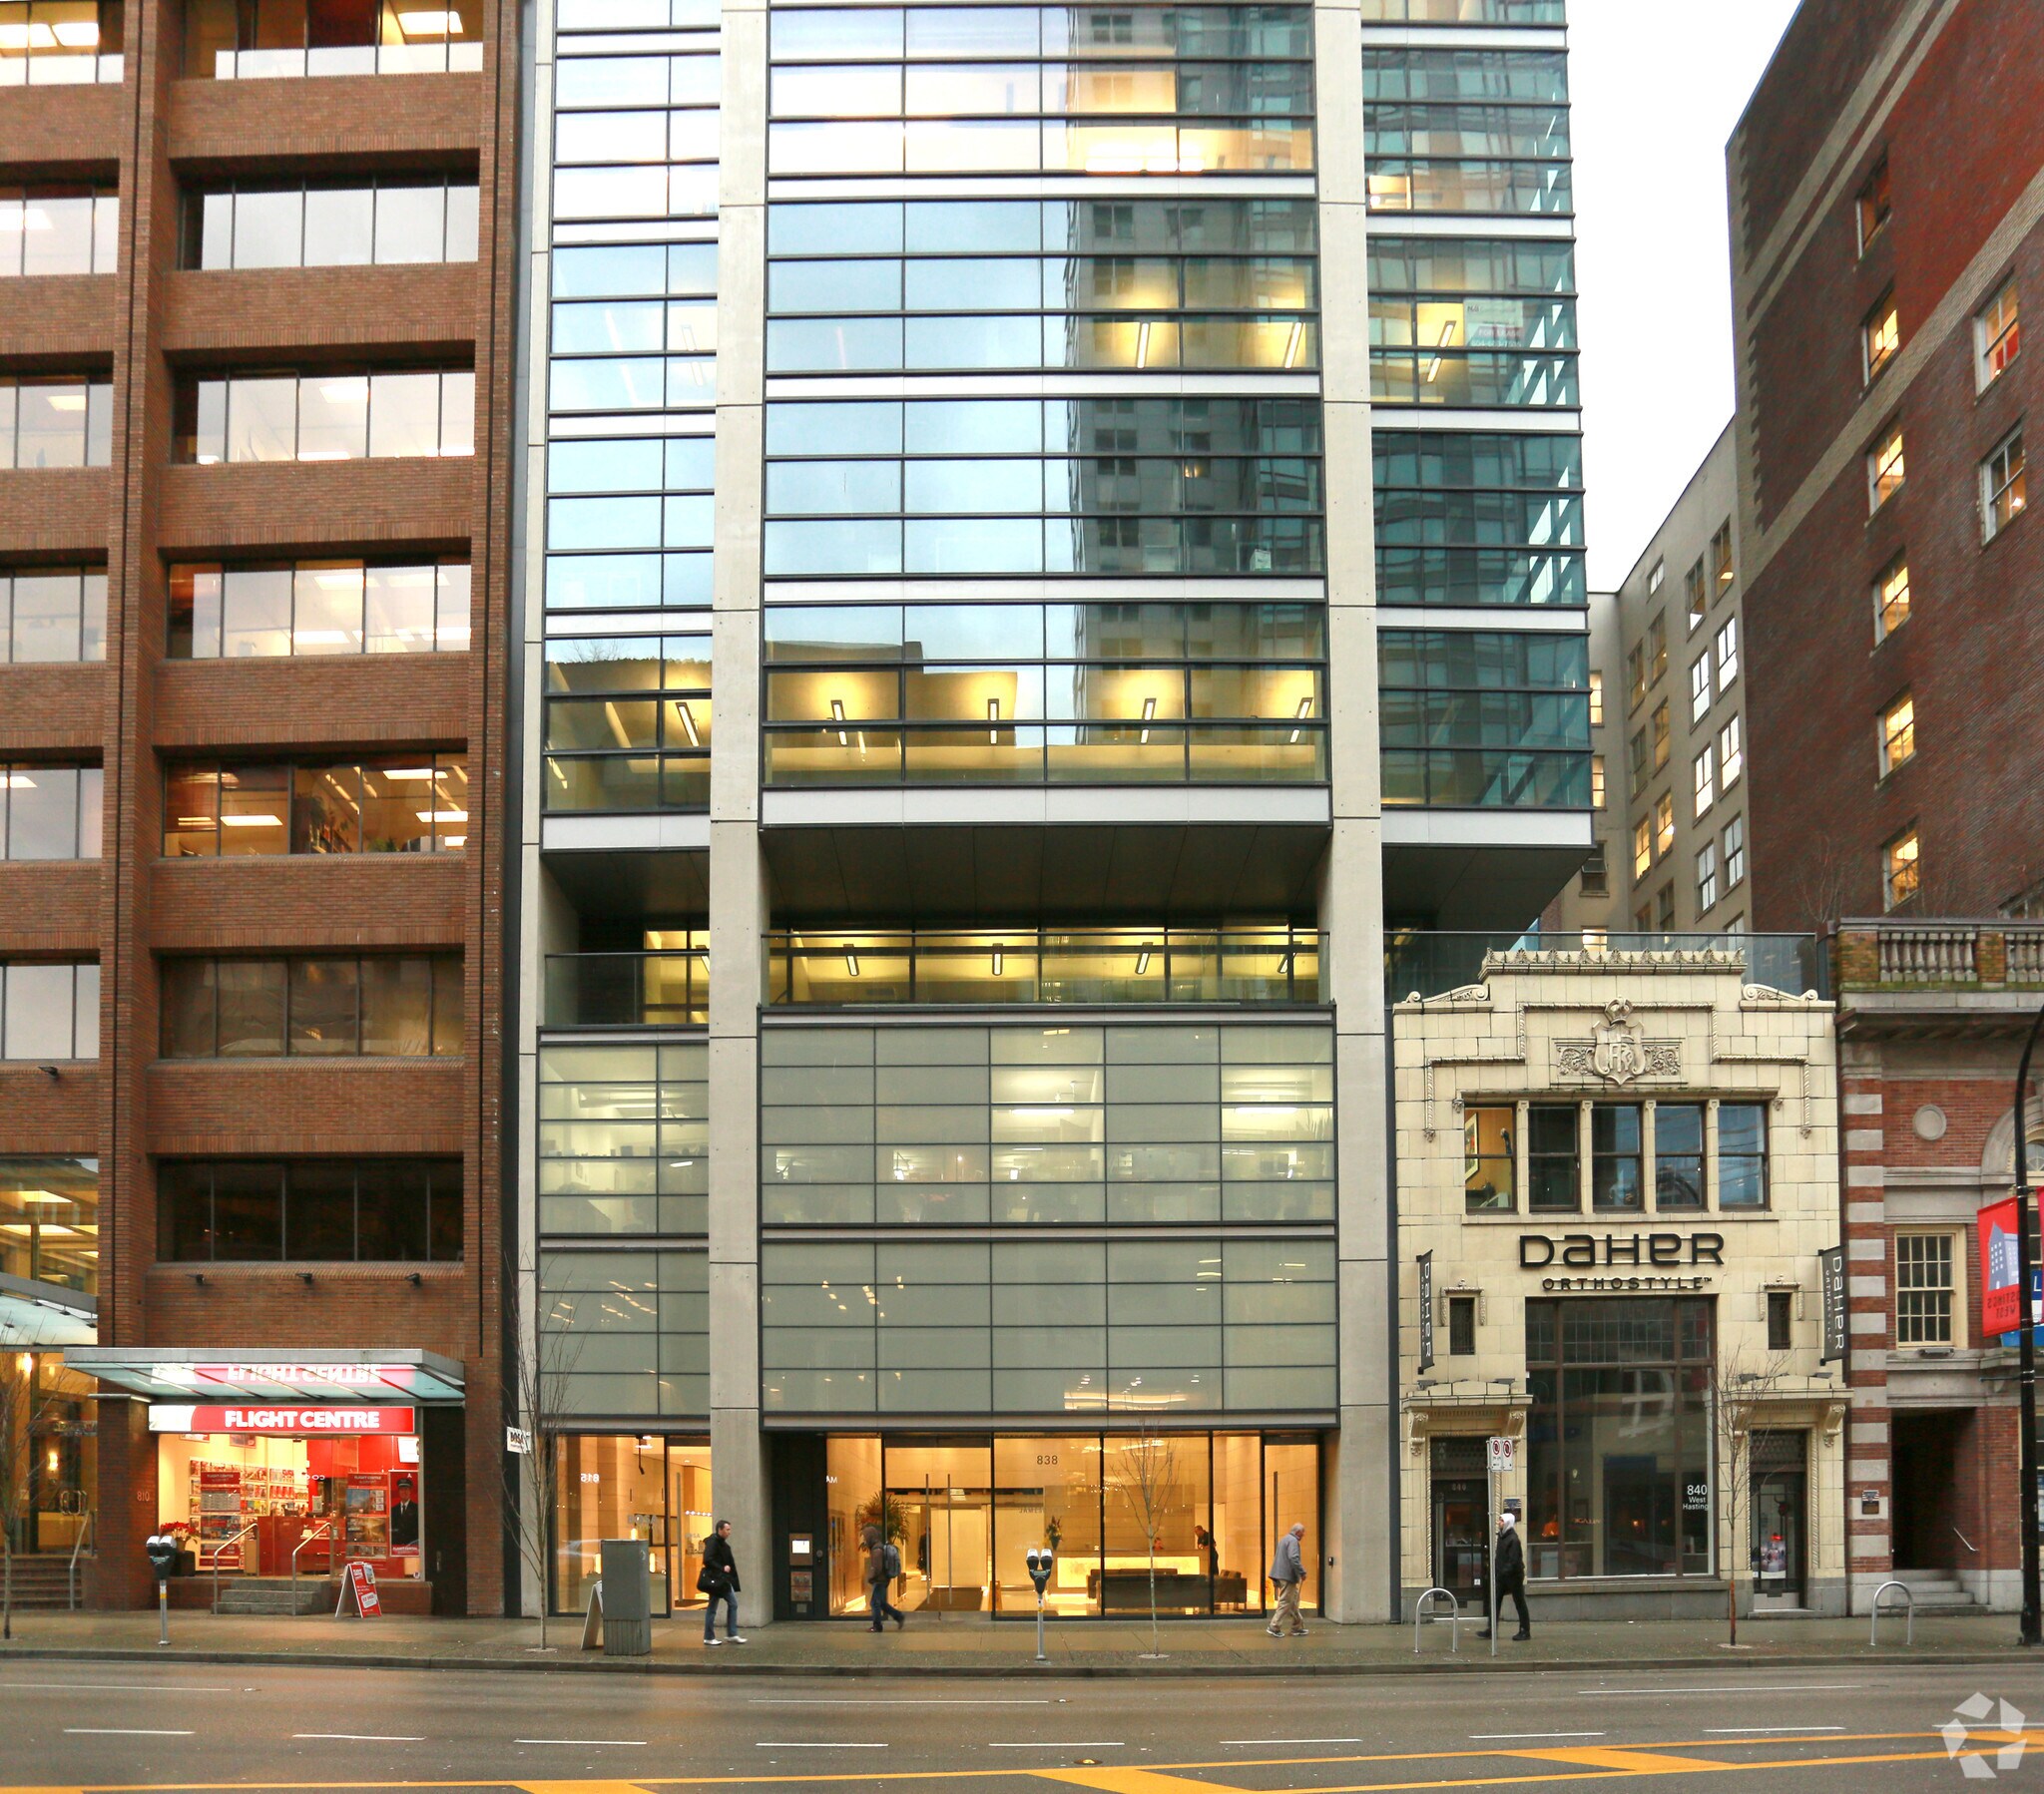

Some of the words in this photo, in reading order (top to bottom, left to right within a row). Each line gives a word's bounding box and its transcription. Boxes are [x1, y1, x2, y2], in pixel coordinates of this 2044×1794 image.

[225, 1410, 297, 1428] FLIGHT
[299, 1410, 380, 1428] CENTRE
[1036, 1455, 1059, 1466] 838
[1687, 1484, 1708, 1496] 840
[136, 1491, 150, 1502] 810
